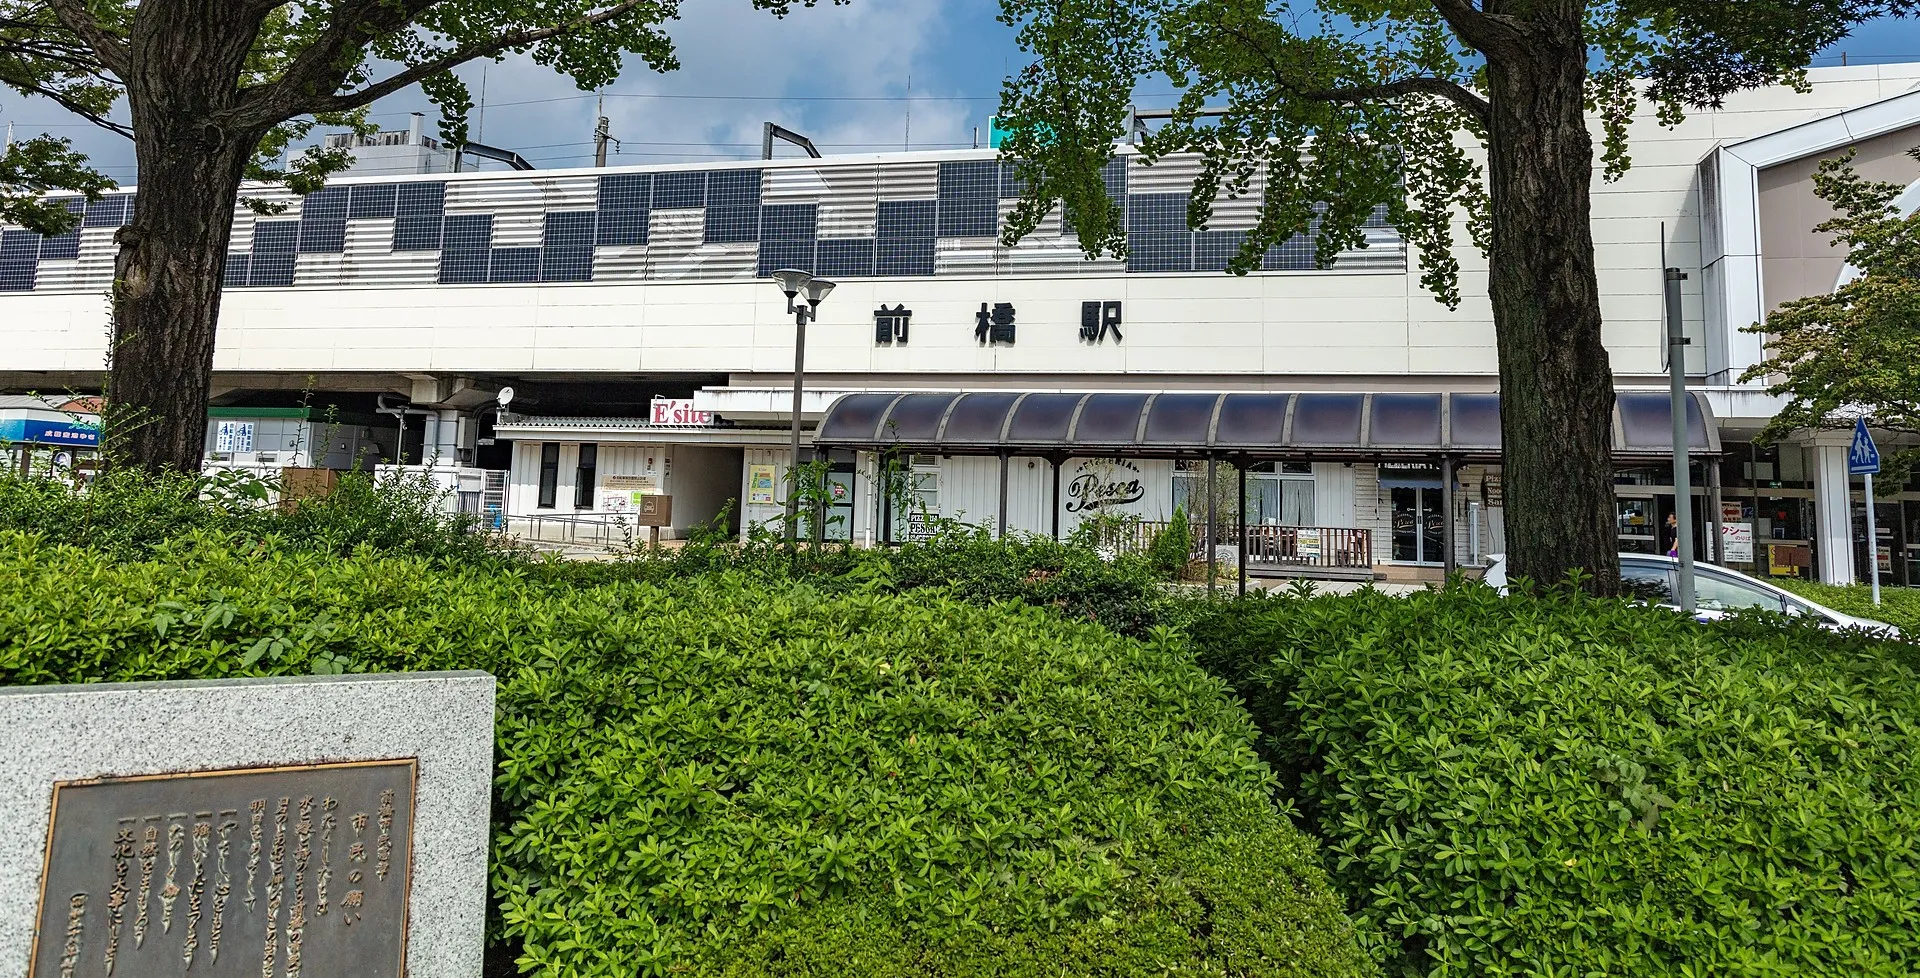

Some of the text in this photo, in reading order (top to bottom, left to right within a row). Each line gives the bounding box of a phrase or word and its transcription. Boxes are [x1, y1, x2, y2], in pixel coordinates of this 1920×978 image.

[874, 301, 1123, 346] 前橋駅
[1066, 474, 1144, 512] Pesca
[1722, 526, 1750, 535] クシー
[340, 812, 369, 926] 市民の願い
